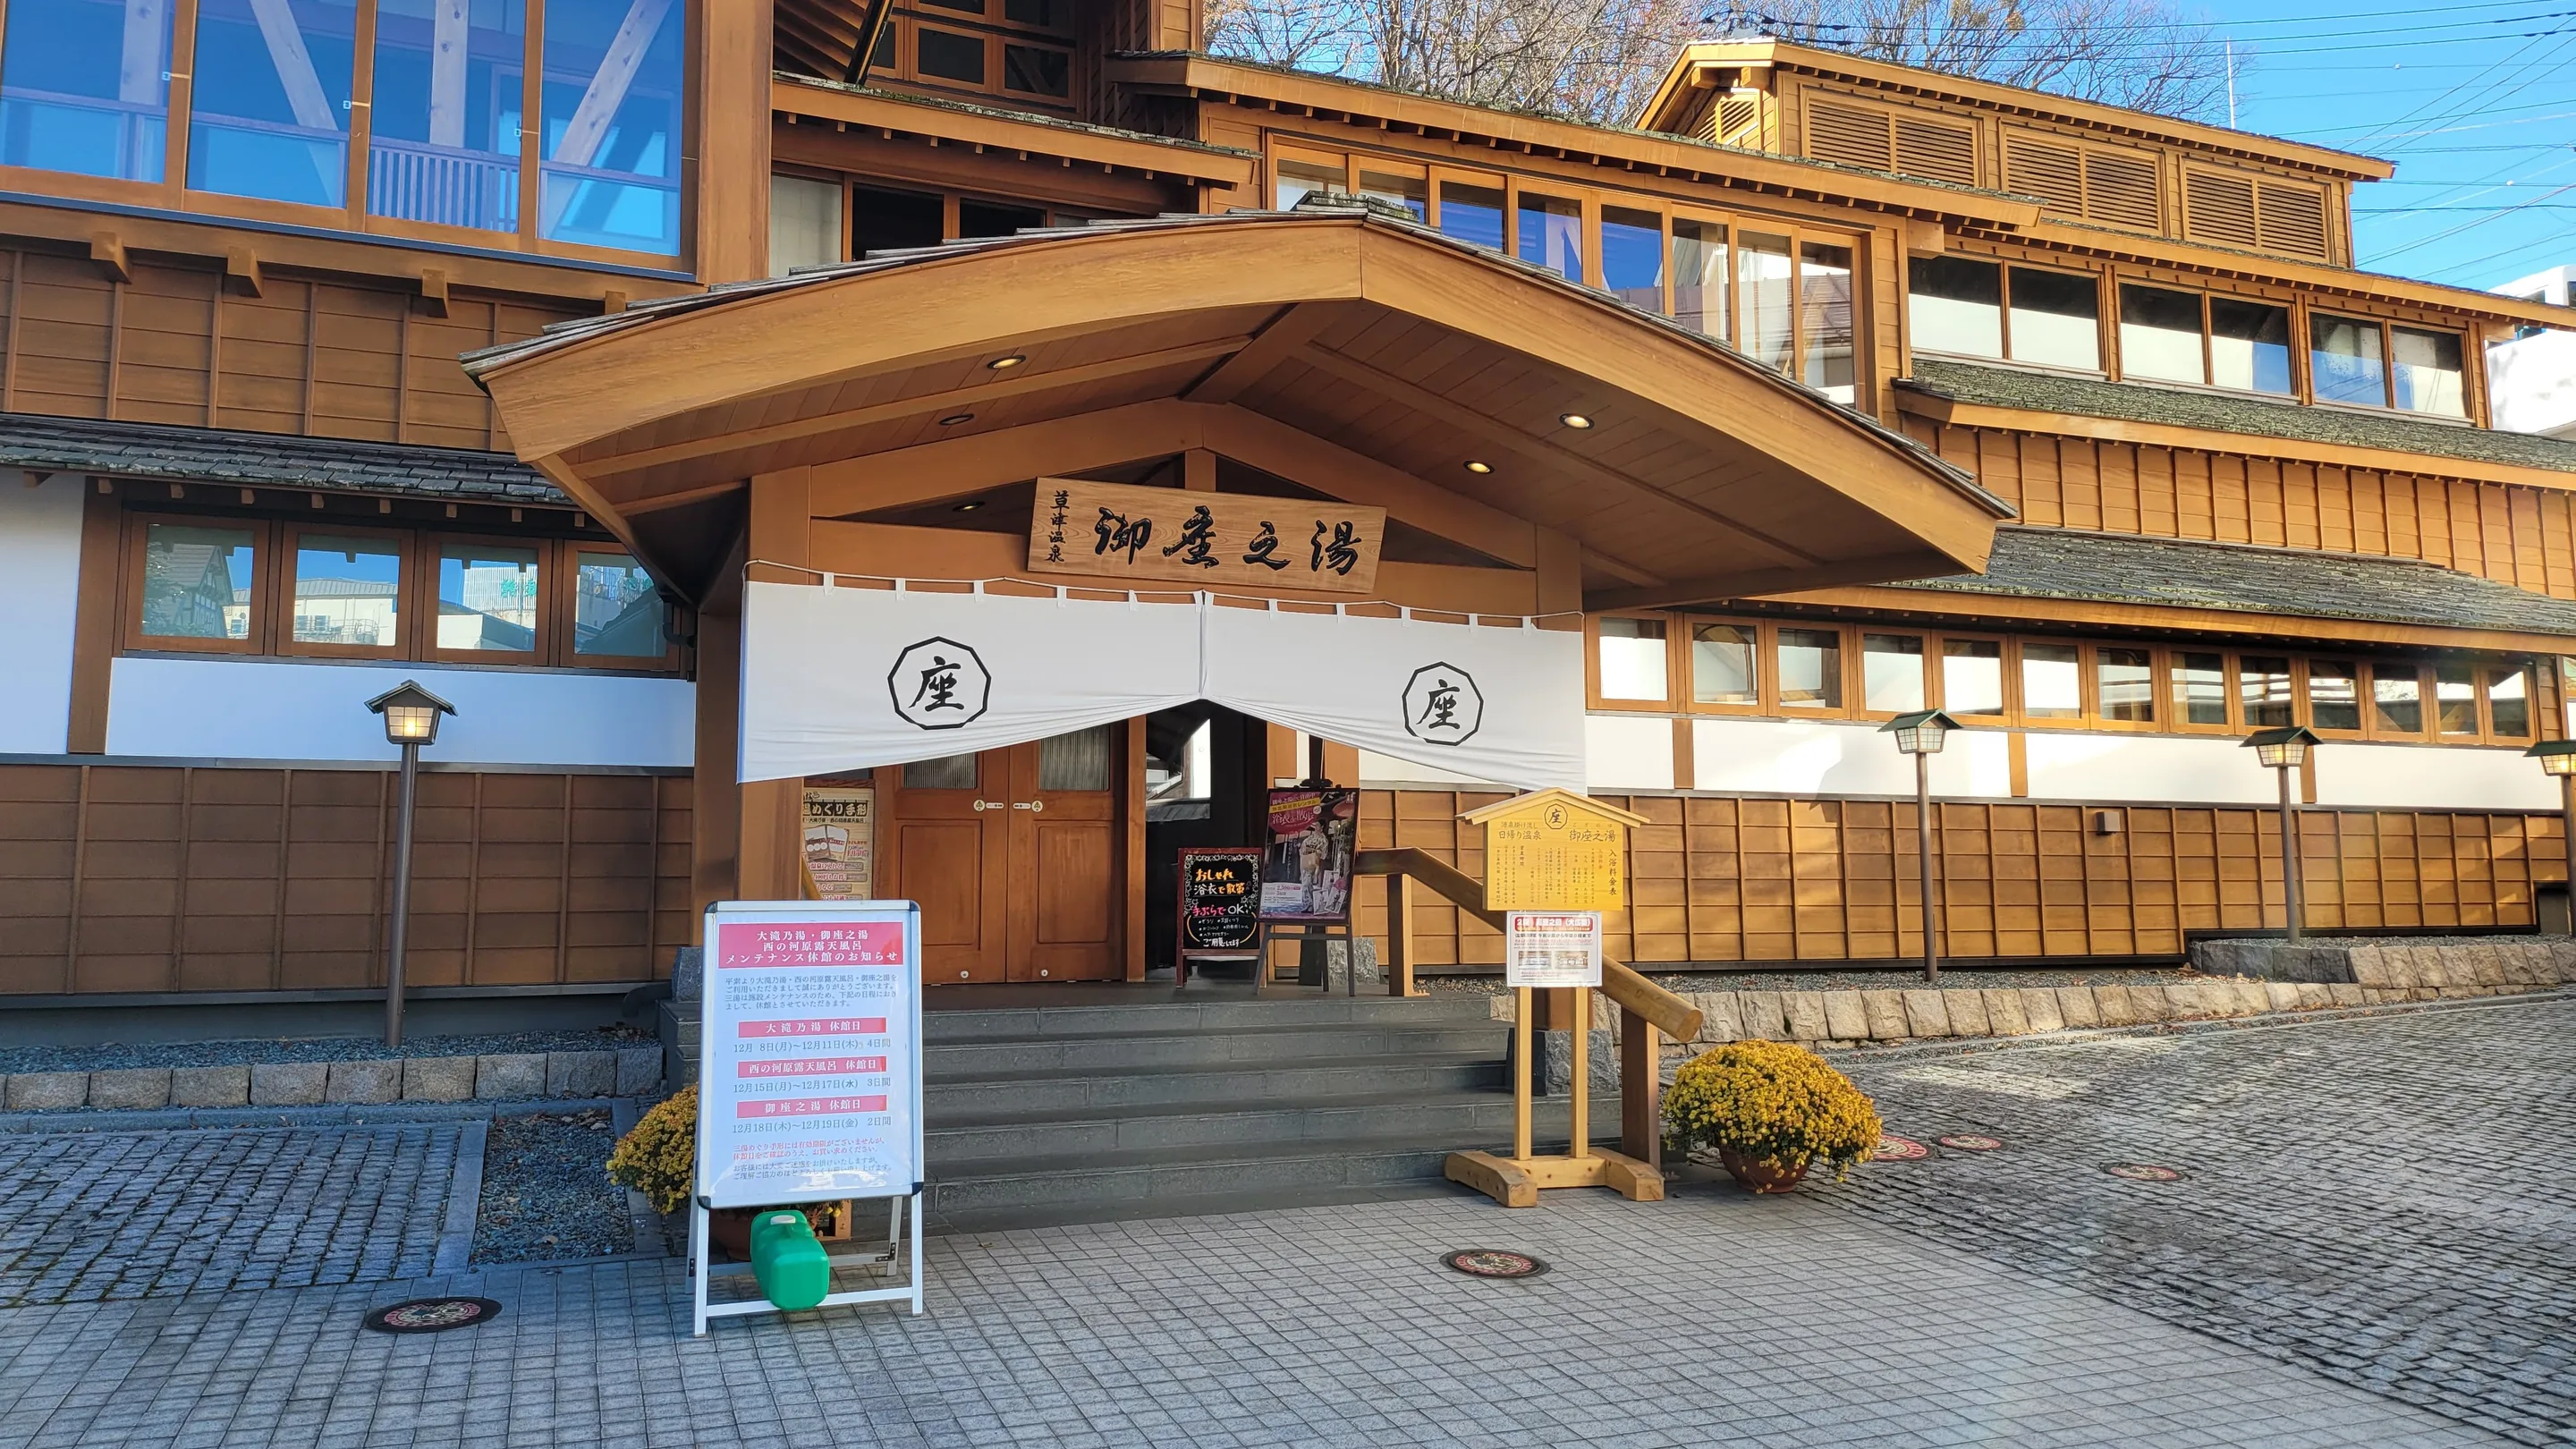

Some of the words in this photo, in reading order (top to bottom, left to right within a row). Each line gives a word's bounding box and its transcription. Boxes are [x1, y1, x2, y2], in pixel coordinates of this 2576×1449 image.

[1044, 490, 1071, 564] 草津温泉
[1094, 505, 1361, 575] 御座之湯
[908, 656, 964, 712] 座
[1416, 679, 1460, 729] 座
[1499, 830, 1541, 840] 日帰り温泉
[1569, 829, 1616, 842] 御座之湯
[1195, 868, 1234, 882] おしゃれ
[1608, 849, 1617, 895] 入浴料金表
[1193, 882, 1245, 895] 浴衣で散策
[757, 929, 869, 941] 大滝乃湯・御座之湯
[763, 941, 862, 952] 西の河原露天風呂
[725, 951, 898, 964] メンテナンス休館のお知らせ
[766, 1021, 821, 1033] 大滝乃湯
[830, 1021, 860, 1031] 休館日
[749, 1061, 837, 1073] 西の河原露天風呂
[845, 1059, 877, 1070] 休館日
[867, 1077, 891, 1087] 3日間
[765, 1101, 821, 1113] 御座之湯
[829, 1099, 860, 1110] 休館日
[868, 1116, 892, 1126] 2日間
